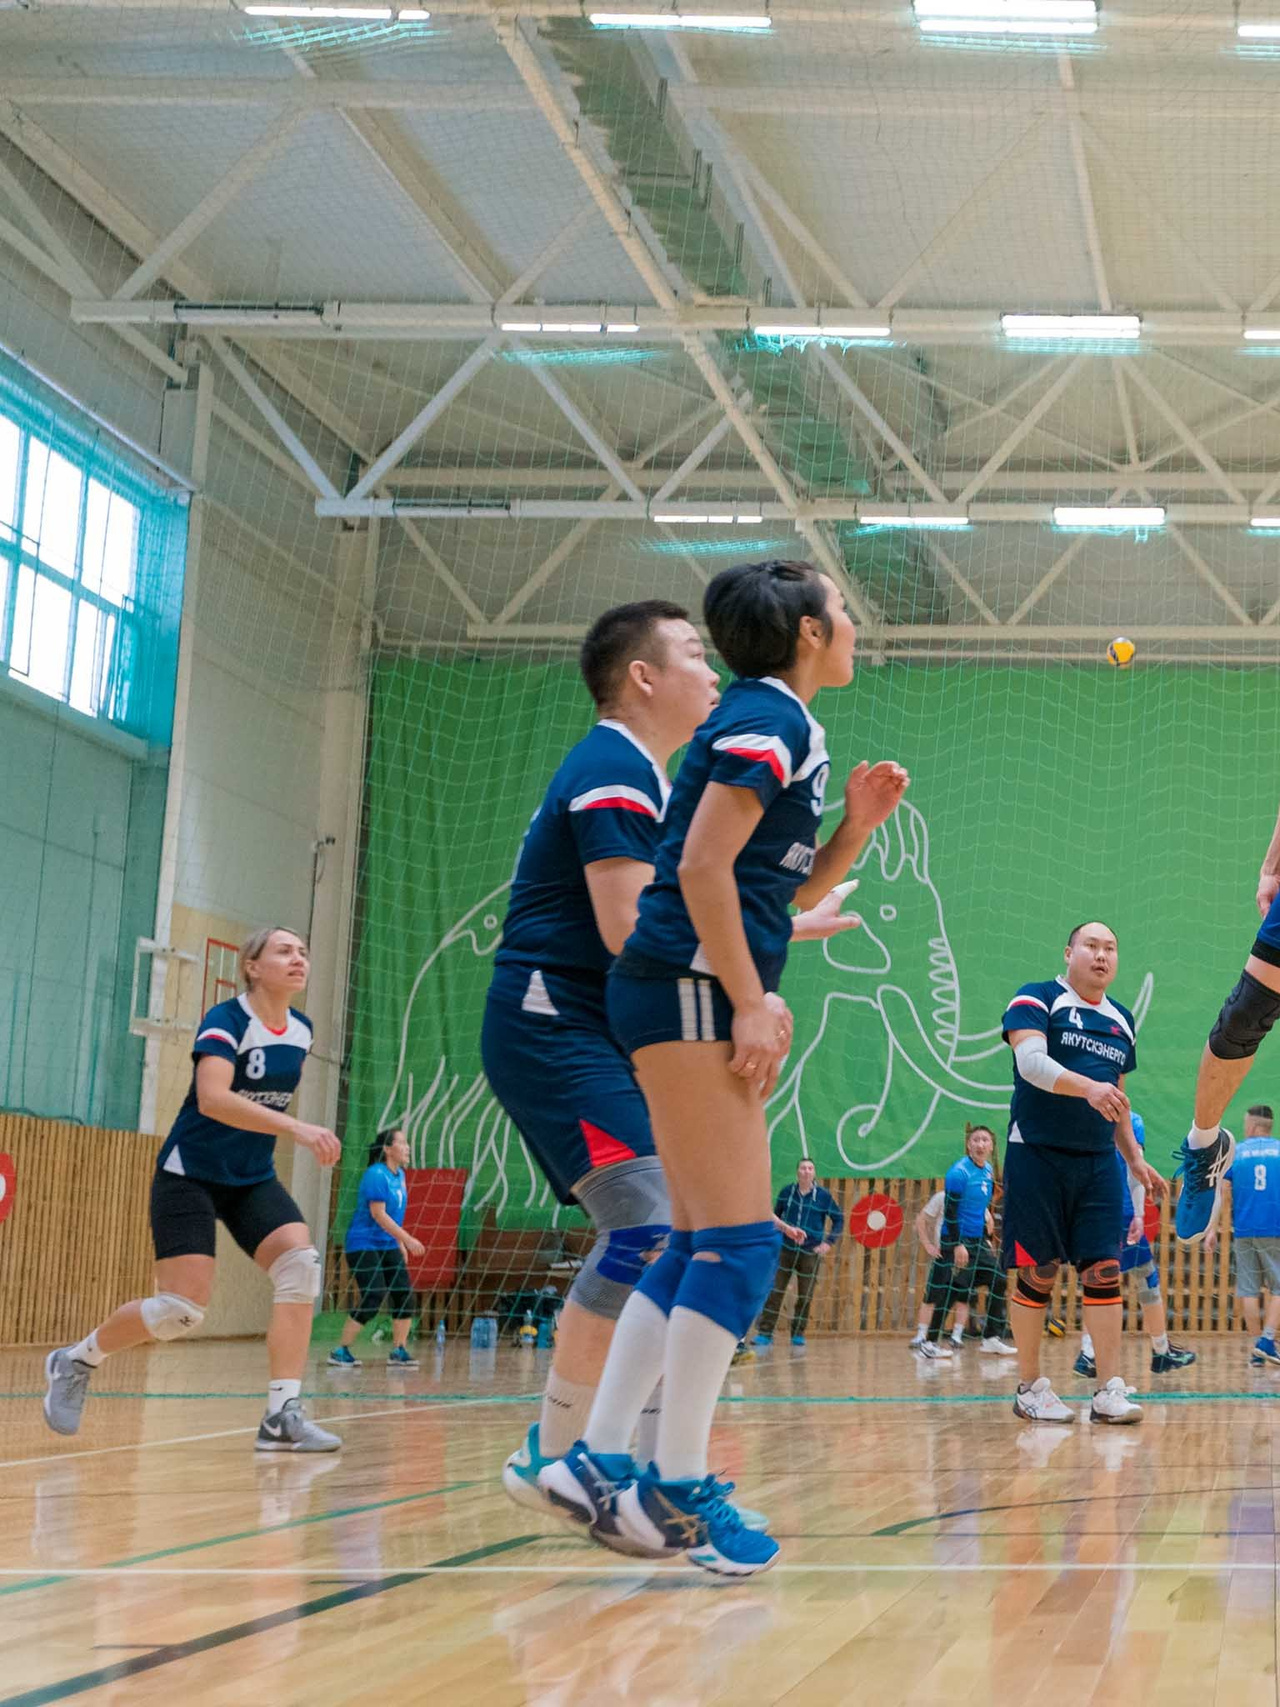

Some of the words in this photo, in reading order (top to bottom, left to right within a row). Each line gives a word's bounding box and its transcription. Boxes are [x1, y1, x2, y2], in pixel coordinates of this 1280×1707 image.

[1068, 1006, 1083, 1030] 4
[1060, 1031, 1127, 1066] ЯКУТСКЭНЕРГО
[245, 1048, 266, 1080] 8
[1254, 1164, 1267, 1191] 8
